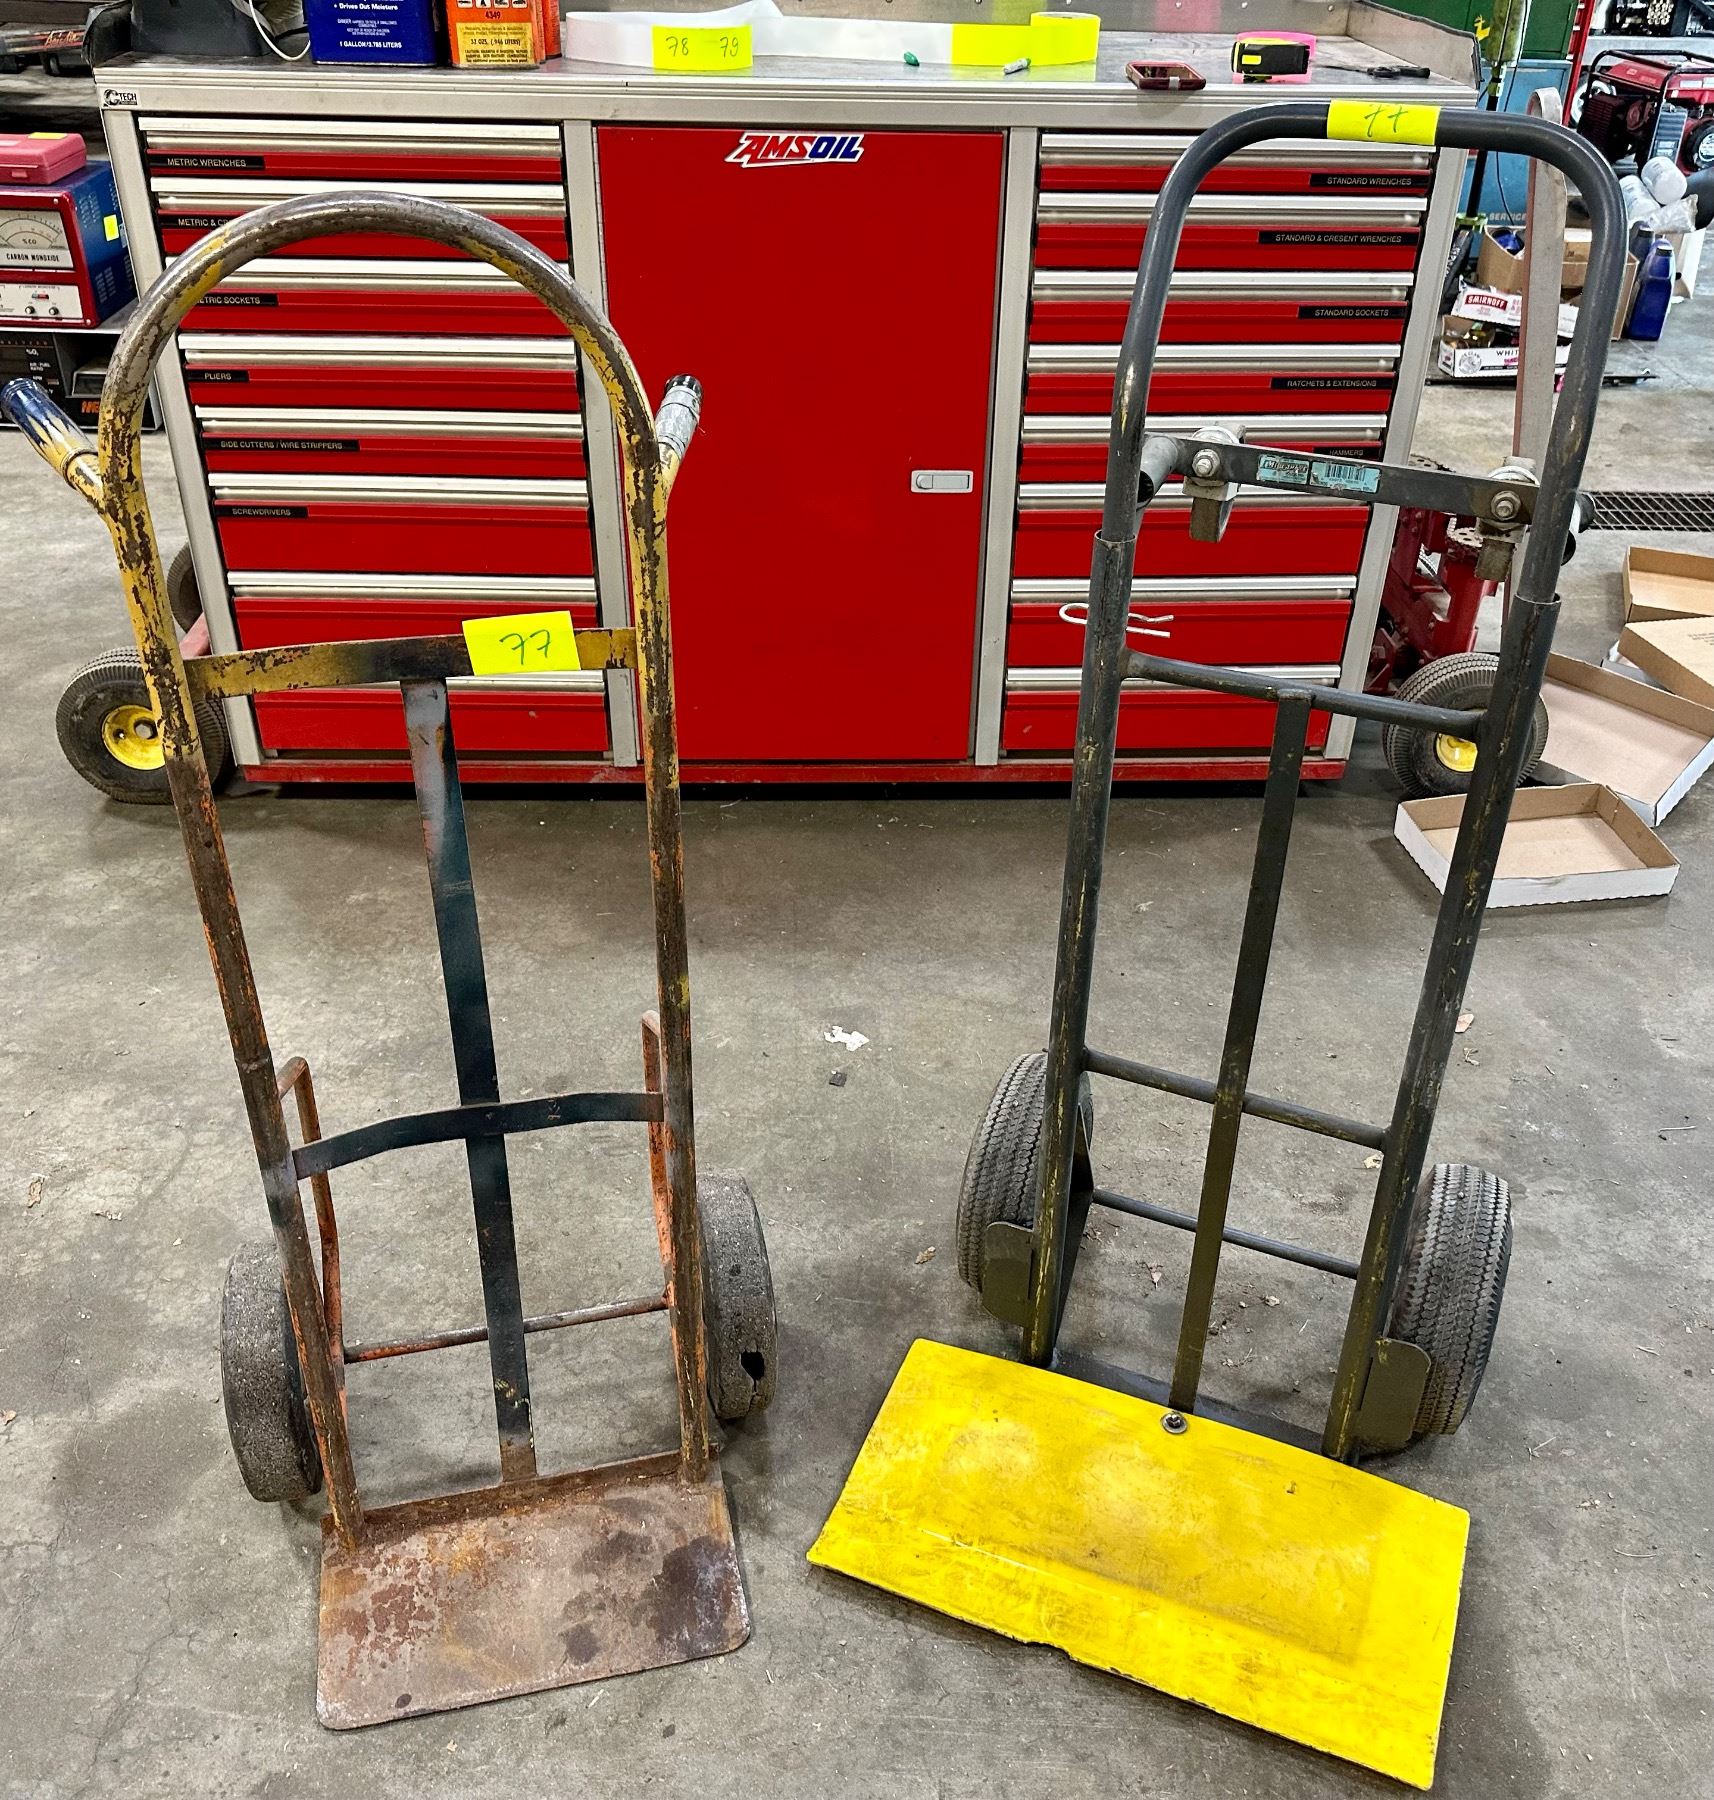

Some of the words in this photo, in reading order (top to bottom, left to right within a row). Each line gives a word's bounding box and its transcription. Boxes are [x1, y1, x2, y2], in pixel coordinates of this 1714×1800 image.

[371, 3, 399, 11] Moisture
[485, 10, 501, 20] 4349
[665, 35, 690, 57] 78
[719, 36, 740, 58] 79
[728, 133, 863, 167] AMSOIL
[167, 158, 200, 167] METRIC
[200, 159, 248, 168] WRENCHES
[1327, 176, 1368, 186] STANDARD
[1369, 177, 1413, 186] WRENCHES
[178, 218, 208, 227] METRIC
[210, 219, 217, 227] &
[1275, 234, 1316, 243] STANDARD
[1317, 234, 1323, 243] &
[1323, 235, 1359, 243] CRESENT
[1359, 235, 1402, 244] WRENCHES
[6, 253, 29, 261] CARBON
[31, 254, 60, 262] MONOXIDE
[199, 296, 222, 304] ETRIC
[223, 296, 261, 305] SOCKETS
[1468, 295, 1505, 308] SMIRNOFF
[1315, 308, 1354, 317] STANDARD
[1354, 309, 1389, 317] SOCKETS
[1496, 349, 1519, 357] WHIT
[204, 372, 232, 380] PLIERS
[1287, 380, 1325, 388] RATCHETS
[1332, 380, 1377, 388] EXTENSIONS
[220, 440, 238, 448] SIDE
[239, 440, 275, 449] CUTTERS
[280, 441, 300, 449] WIRE
[300, 441, 343, 450] STRIPPERS
[1329, 448, 1364, 457] HAMMERS
[232, 508, 292, 517] SCREWDRIVERS
[498, 629, 551, 665] 77
